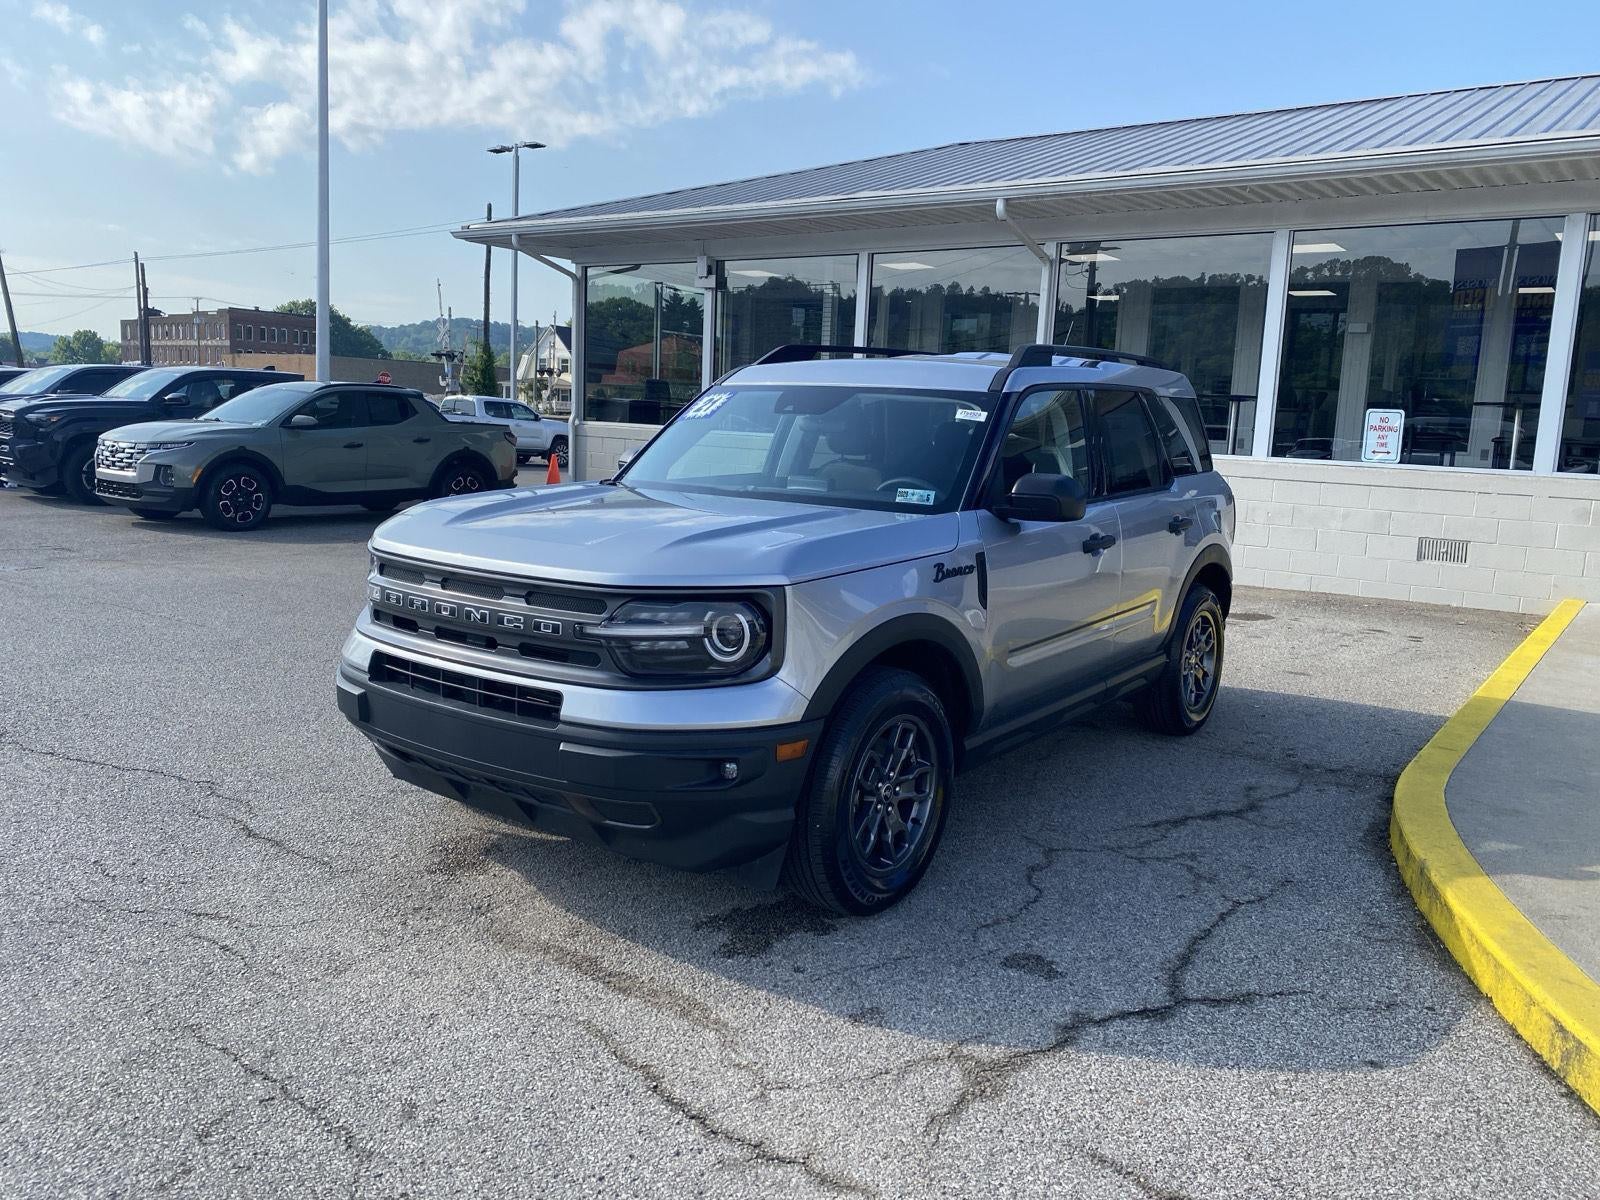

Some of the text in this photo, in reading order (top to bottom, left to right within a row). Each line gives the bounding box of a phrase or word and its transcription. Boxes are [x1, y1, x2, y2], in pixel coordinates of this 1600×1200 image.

[379, 375, 391, 383] STOP
[1380, 416, 1390, 424] NO
[1370, 425, 1399, 433] PARKING
[925, 494, 931, 502] 5
[933, 562, 976, 583] Bronco
[384, 589, 562, 636] BRONCO
